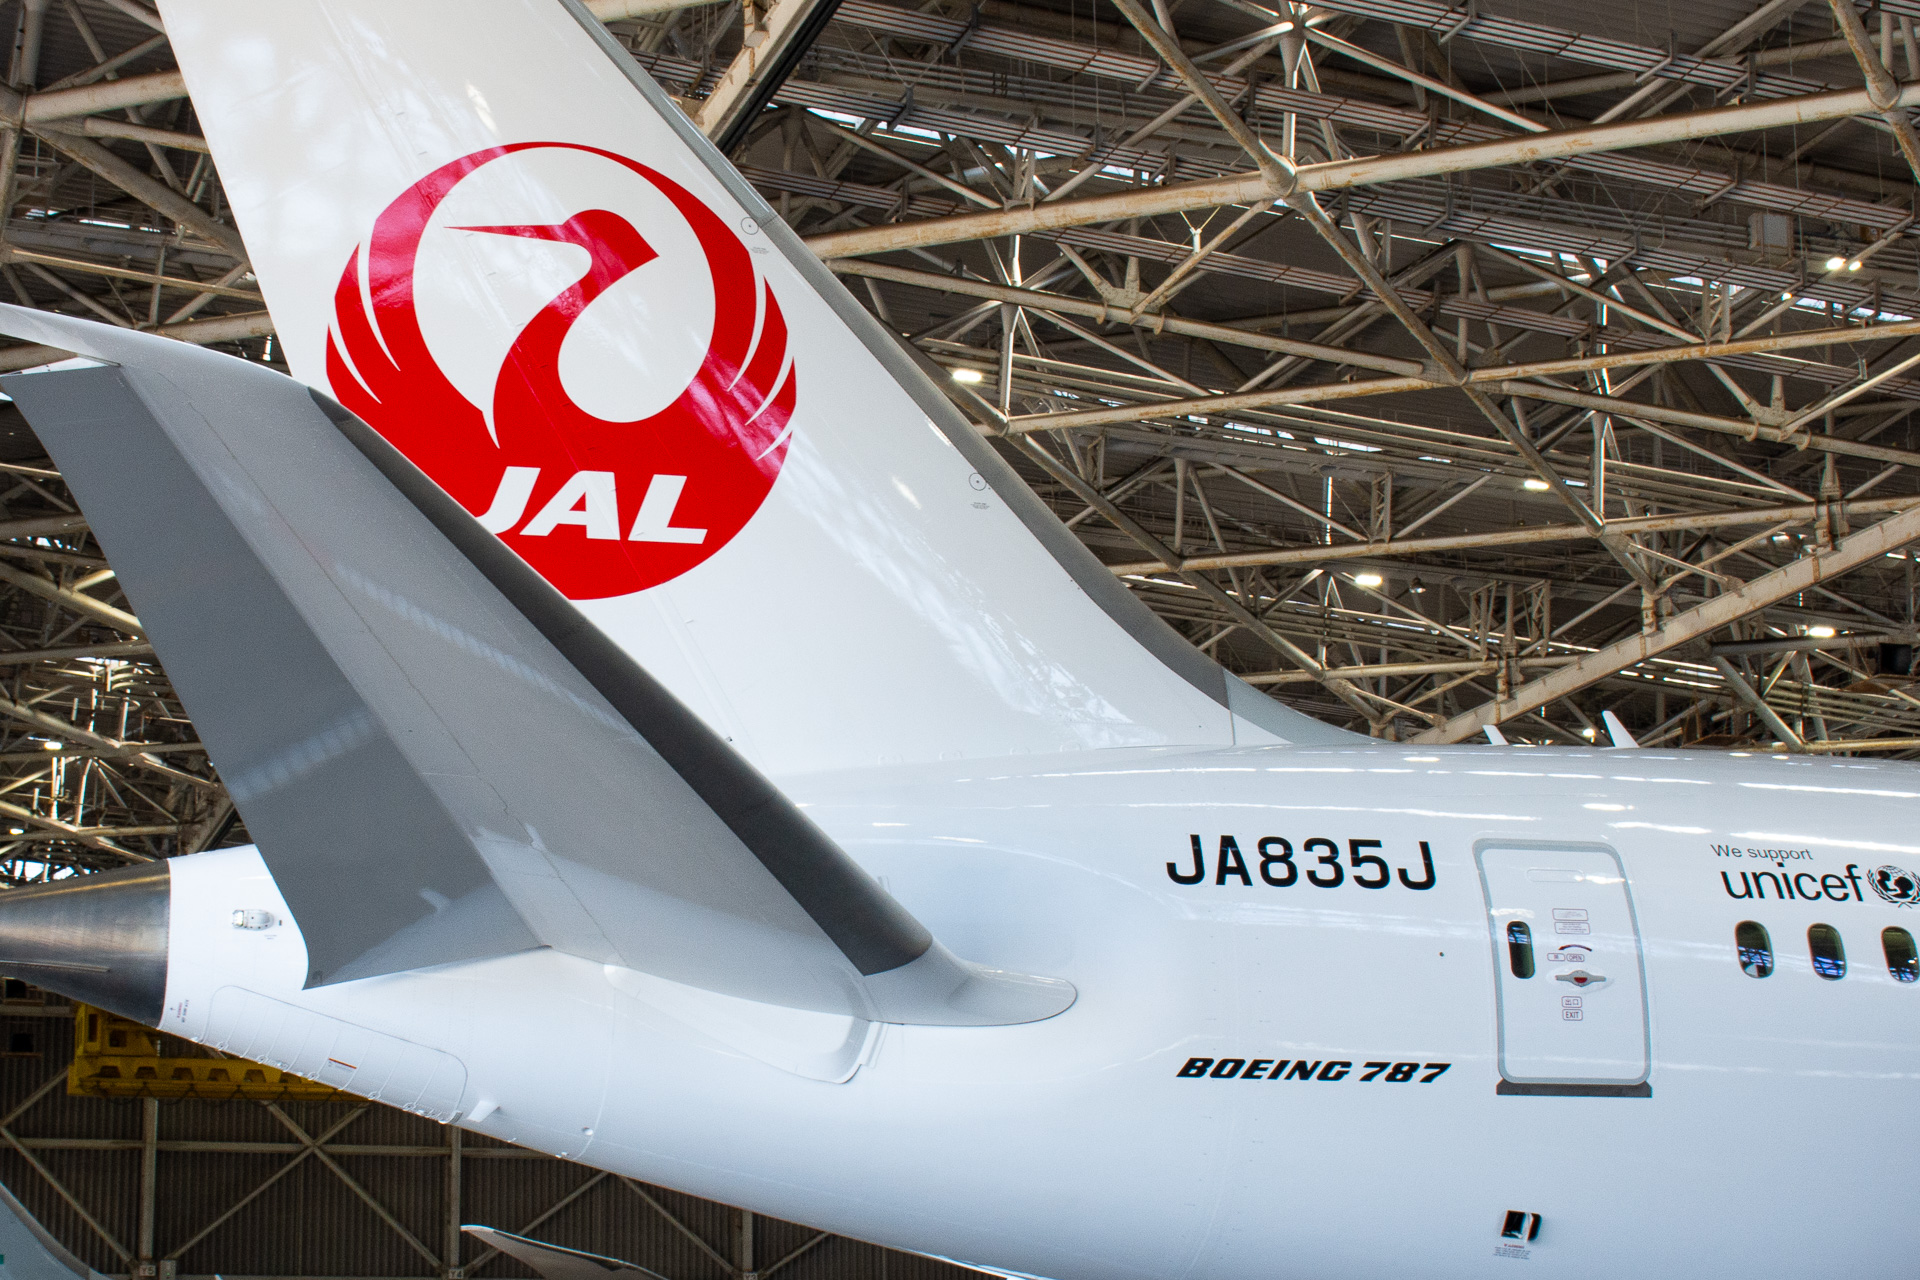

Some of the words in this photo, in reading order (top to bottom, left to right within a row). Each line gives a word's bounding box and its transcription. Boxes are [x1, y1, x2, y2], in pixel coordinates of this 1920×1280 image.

[475, 466, 708, 545] JAL
[1166, 834, 1437, 891] JA835J
[1710, 844, 1742, 858] We
[1747, 848, 1814, 862] support
[1720, 862, 1864, 902] unicef
[1565, 1011, 1579, 1019] EXIT
[1176, 1057, 1353, 1081] BOEING
[1358, 1061, 1452, 1083] 787
